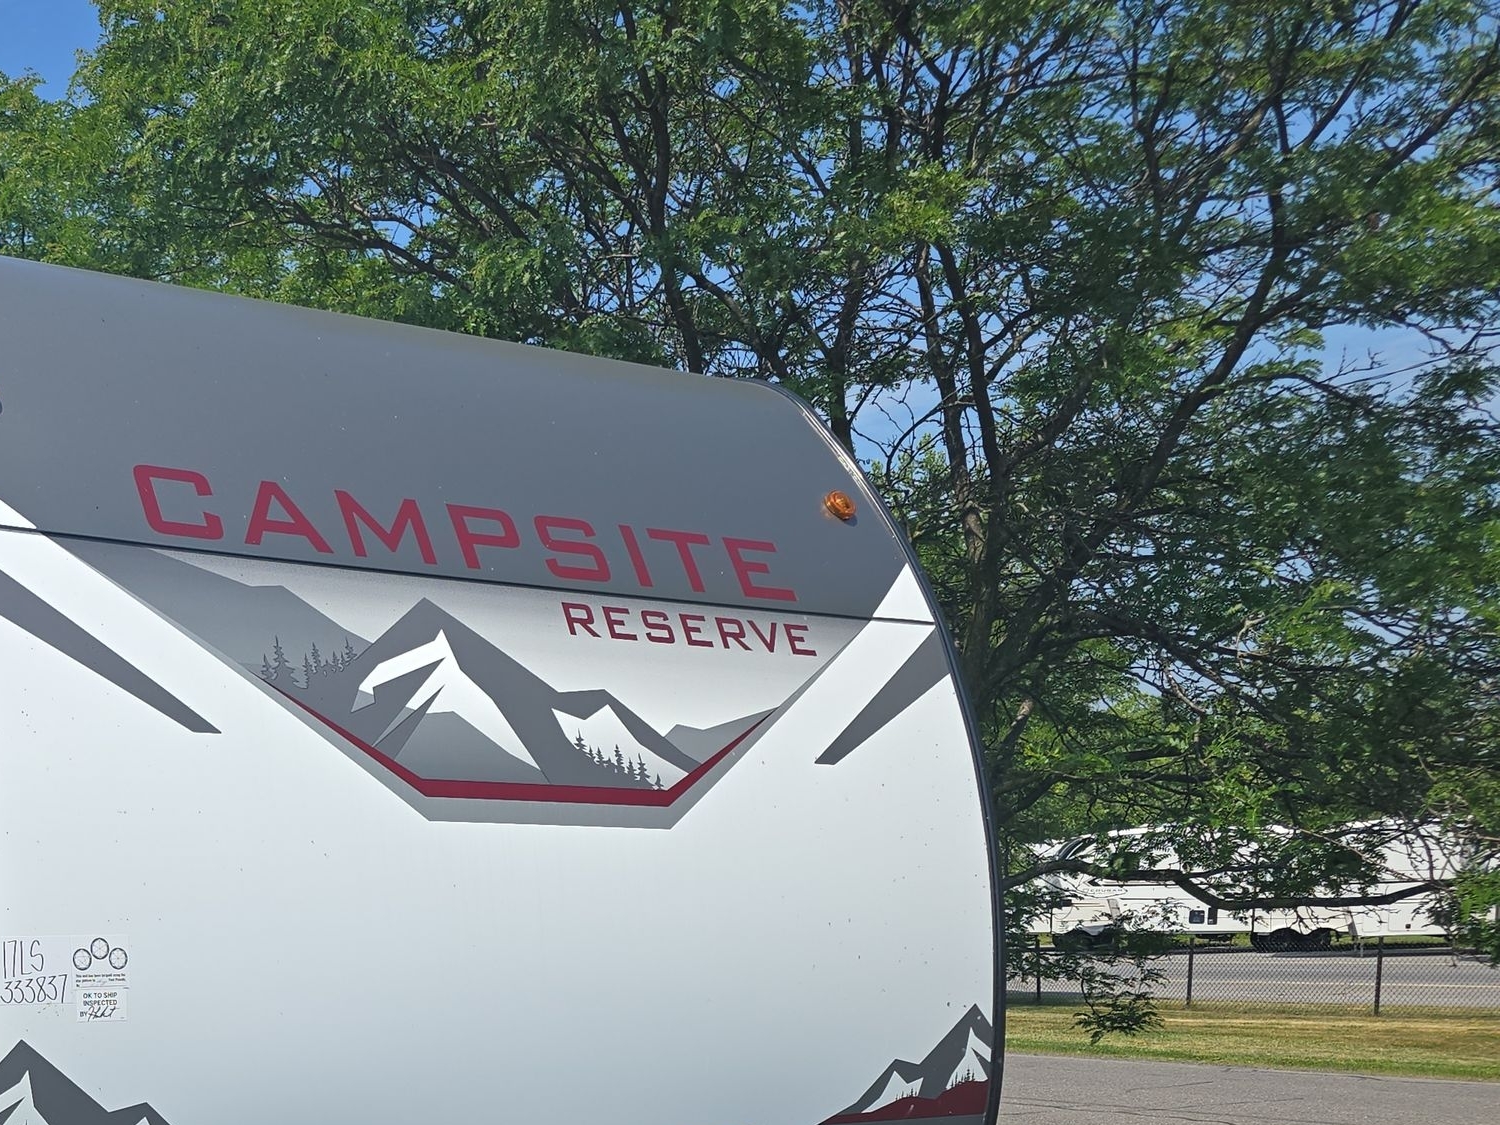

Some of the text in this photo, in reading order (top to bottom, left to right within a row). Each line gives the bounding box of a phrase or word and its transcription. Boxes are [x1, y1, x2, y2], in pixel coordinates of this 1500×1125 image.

[132, 463, 798, 603] CAMPSITE
[560, 601, 818, 657] RESERVE
[3, 939, 45, 979] 17LS
[0, 974, 68, 1004] 333837
